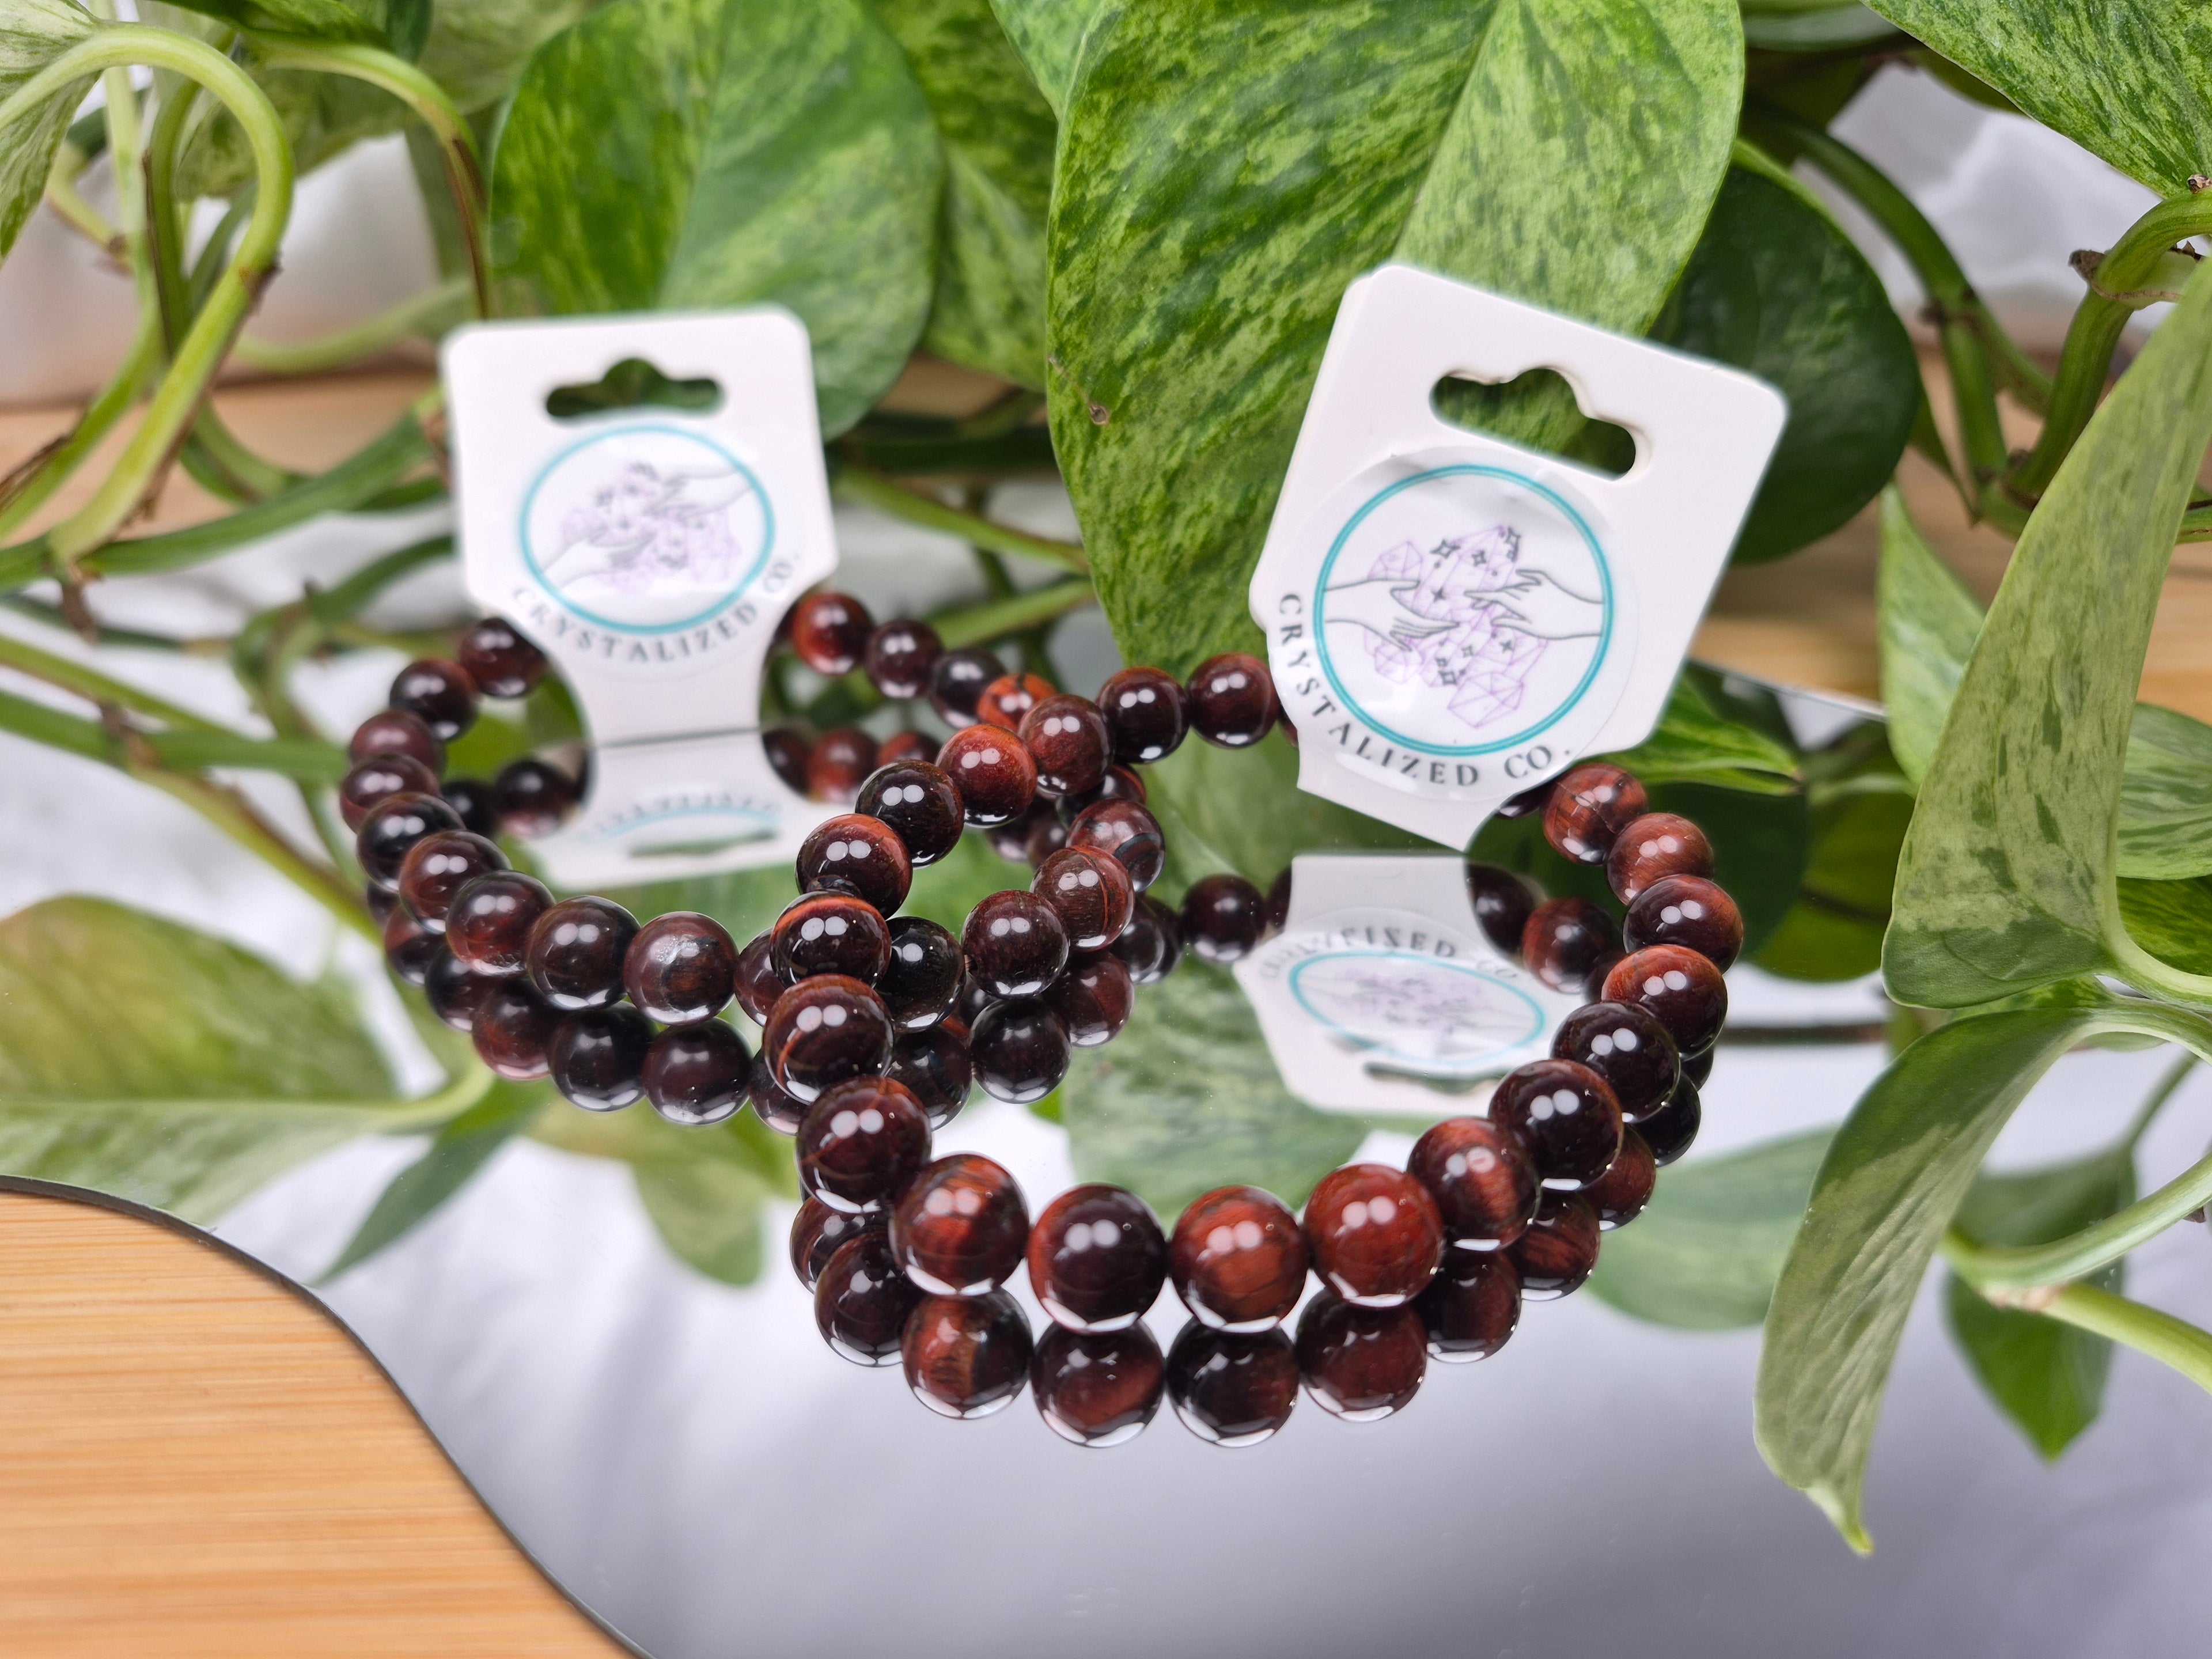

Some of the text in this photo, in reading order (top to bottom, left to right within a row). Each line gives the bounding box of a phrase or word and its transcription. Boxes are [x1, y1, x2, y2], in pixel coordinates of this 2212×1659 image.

[513, 588, 759, 663] CRYSTALIZED
[1279, 593, 1571, 786] CRYSTALIZED CO.
